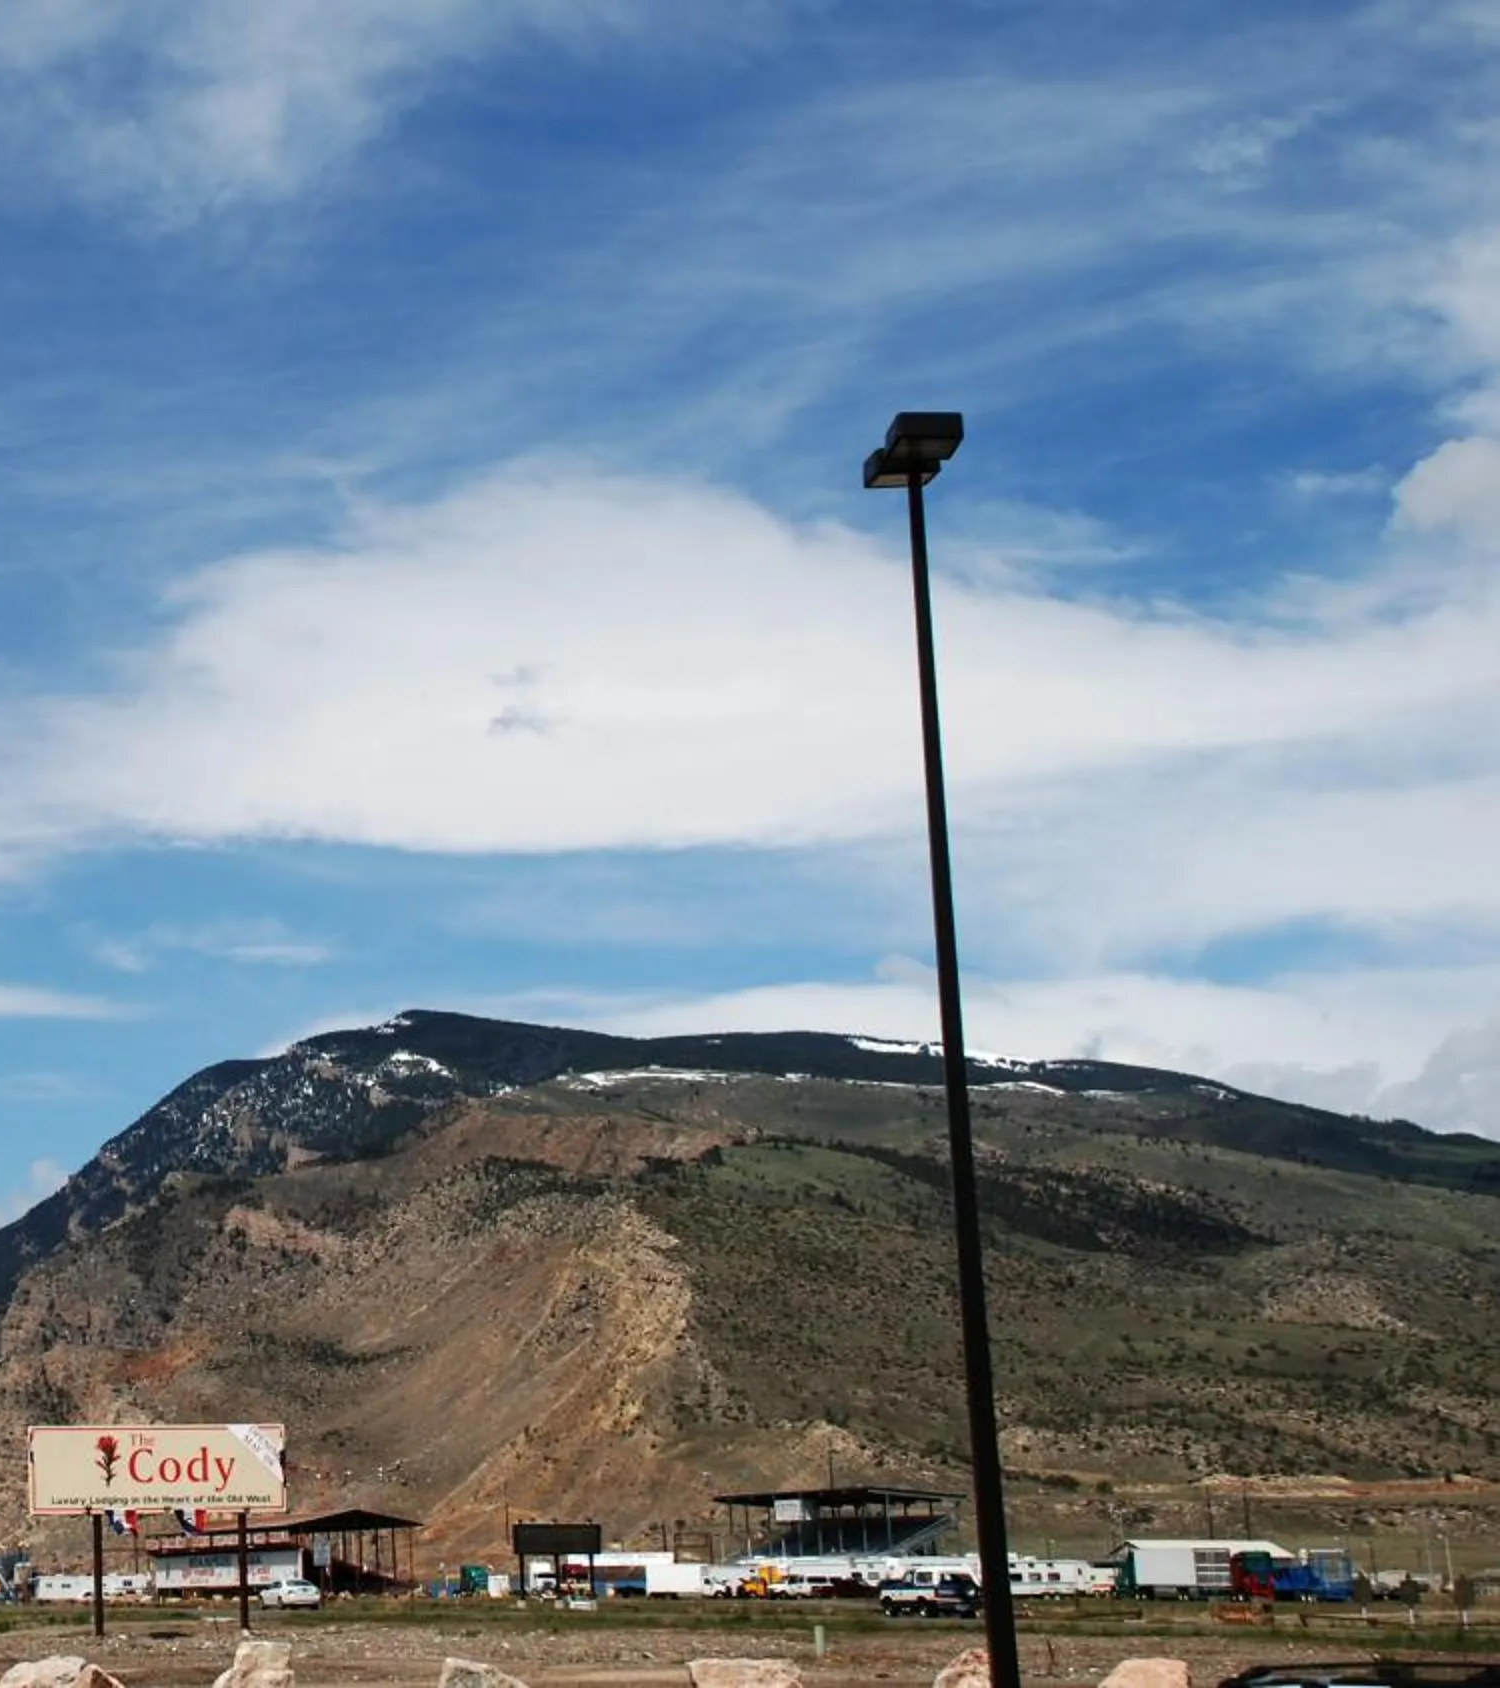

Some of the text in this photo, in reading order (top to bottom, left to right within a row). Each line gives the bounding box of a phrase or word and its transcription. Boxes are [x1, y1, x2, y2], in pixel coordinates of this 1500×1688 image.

[130, 1433, 155, 1446] The
[128, 1446, 236, 1493] Cody
[51, 1495, 86, 1506] Luxury
[90, 1495, 129, 1506] Lodging
[131, 1496, 141, 1504] in
[143, 1495, 160, 1504] the
[193, 1495, 204, 1503] of
[207, 1495, 224, 1503] the
[227, 1494, 243, 1503] Old
[246, 1494, 271, 1503] West
